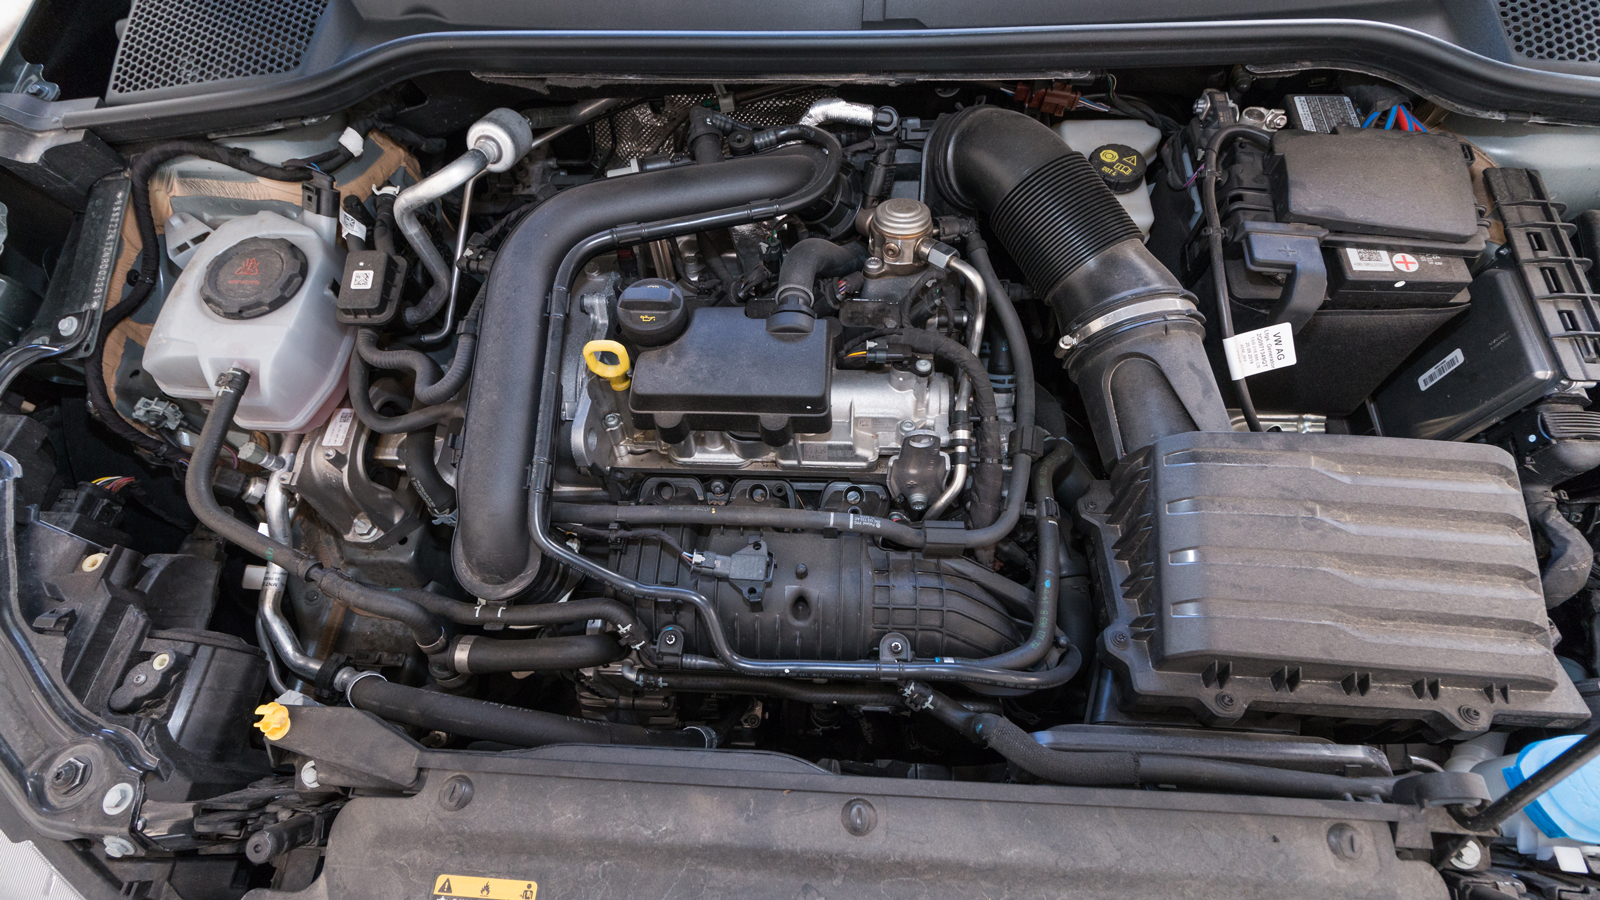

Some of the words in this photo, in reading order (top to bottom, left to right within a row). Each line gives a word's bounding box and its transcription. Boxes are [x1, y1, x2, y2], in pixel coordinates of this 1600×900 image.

[1101, 165, 1113, 174] DOT
[1273, 331, 1283, 346] VW
[1267, 343, 1275, 369] Generator
[1275, 348, 1286, 361] AG
